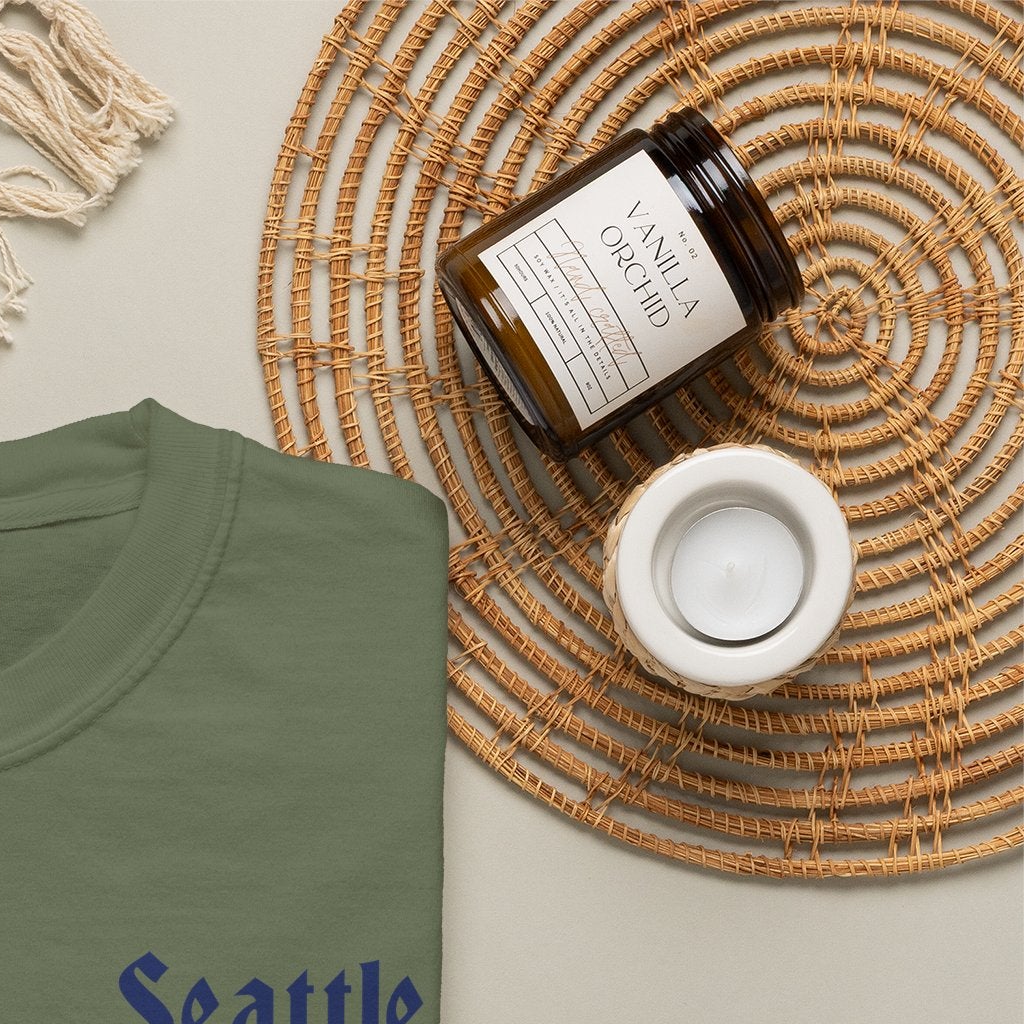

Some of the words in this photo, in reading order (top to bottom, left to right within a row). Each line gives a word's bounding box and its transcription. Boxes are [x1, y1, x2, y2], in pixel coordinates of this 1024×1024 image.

[600, 225, 671, 329] ORCHID
[626, 200, 701, 319] VANILLA
[678, 231, 688, 247] No.
[688, 248, 698, 260] 02
[533, 254, 545, 267] SOY
[544, 269, 555, 283] WAX
[558, 291, 570, 307] IT'S
[568, 309, 578, 322] ALL
[578, 324, 586, 334] IN
[585, 335, 595, 350] THE
[593, 351, 612, 381] DETAILS
